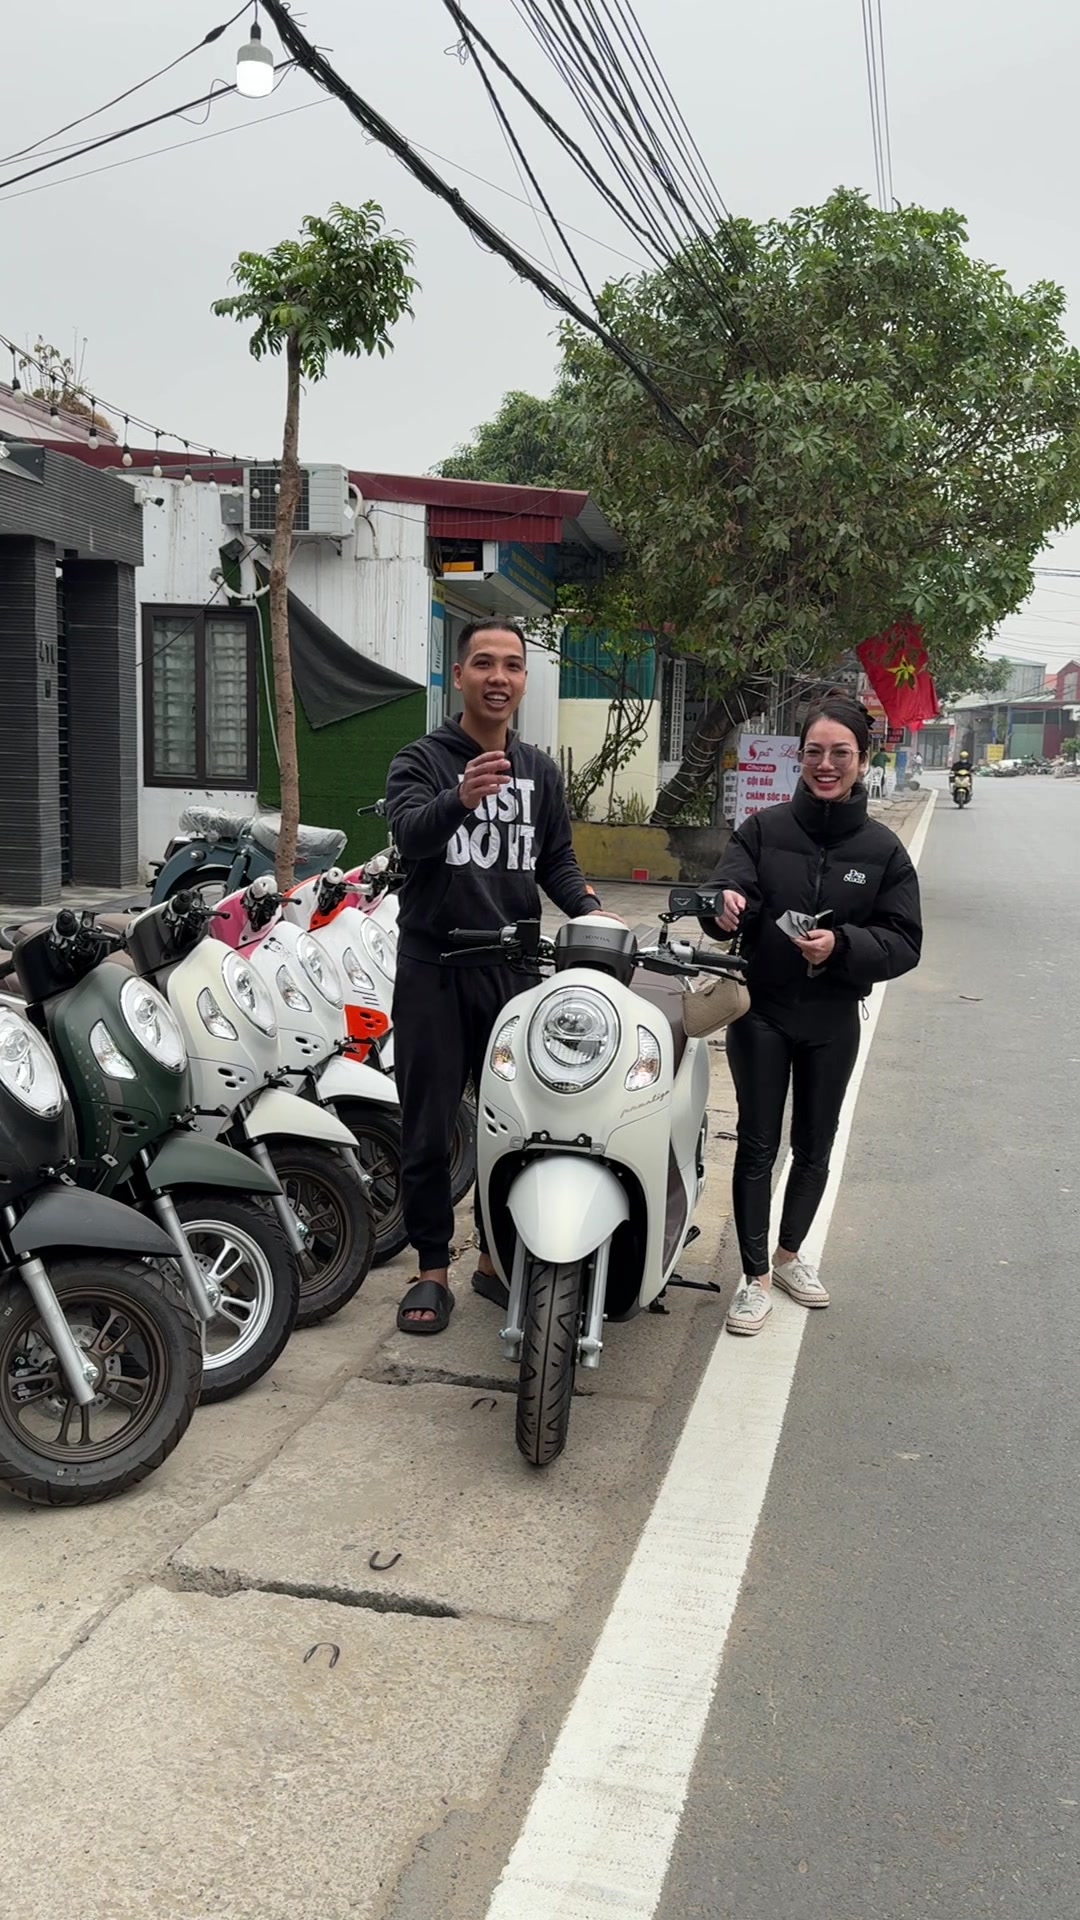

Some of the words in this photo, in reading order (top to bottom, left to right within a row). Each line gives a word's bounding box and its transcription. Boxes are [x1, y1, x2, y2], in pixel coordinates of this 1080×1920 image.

[458, 774, 535, 823] UST
[745, 790, 766, 801] CHĂM
[767, 792, 781, 802] SÓC
[782, 793, 791, 802] DA
[445, 822, 501, 870] DO
[582, 934, 611, 943] HONDA
